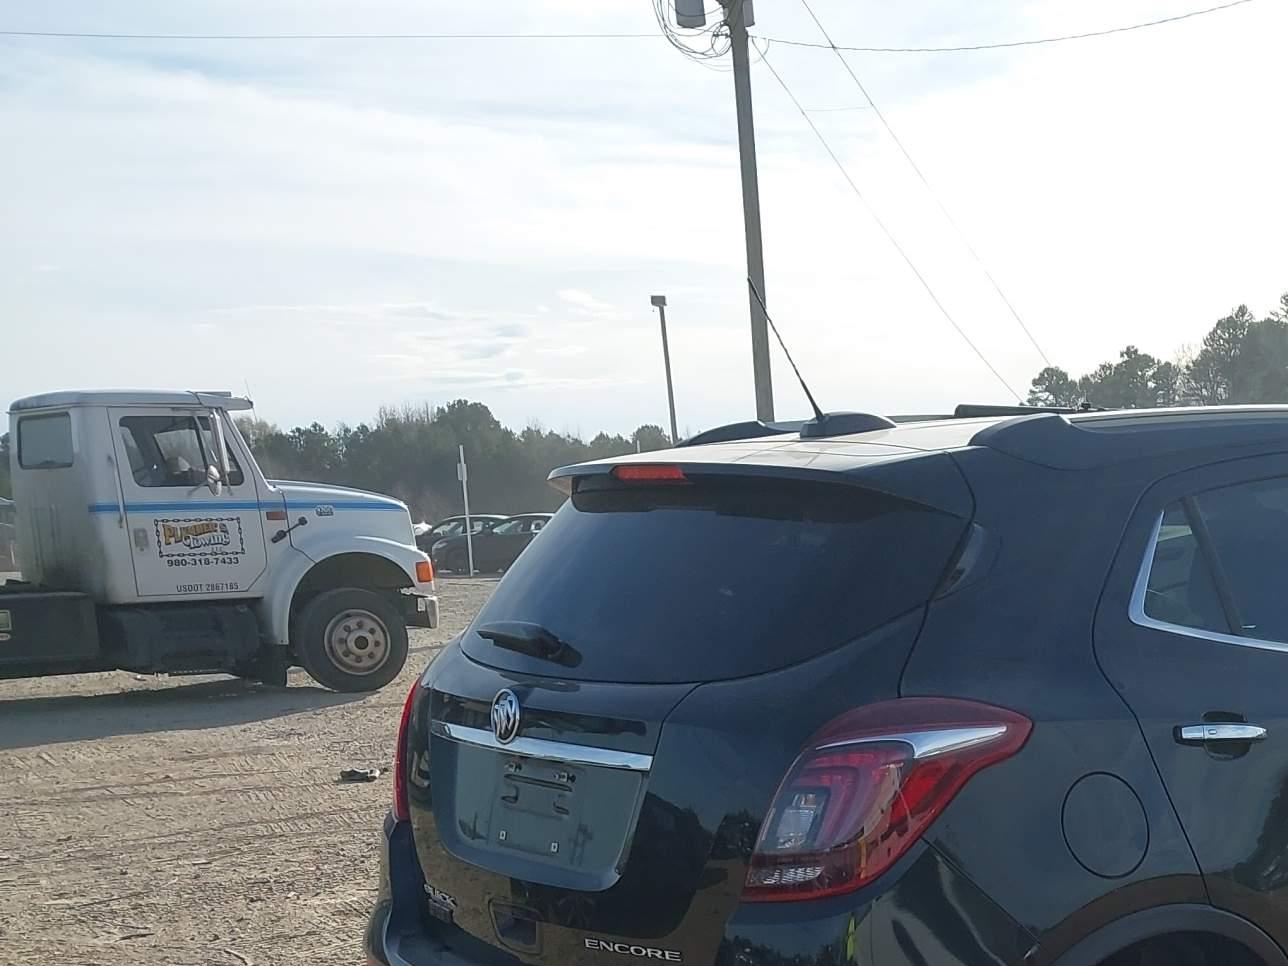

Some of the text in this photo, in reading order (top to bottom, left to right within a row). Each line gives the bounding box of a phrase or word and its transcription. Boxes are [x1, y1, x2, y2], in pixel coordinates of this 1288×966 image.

[167, 557, 239, 567] 980-318-7433
[176, 583, 203, 592] USDOT
[584, 938, 682, 962] ENCORE
